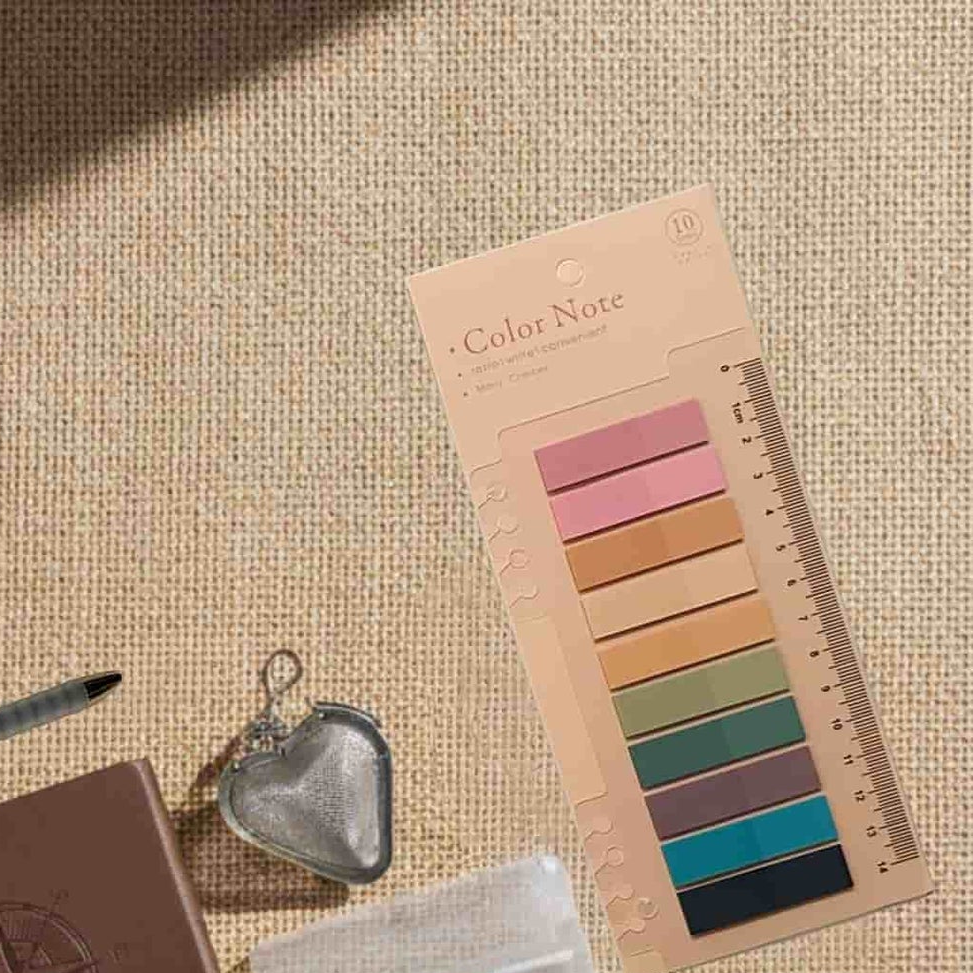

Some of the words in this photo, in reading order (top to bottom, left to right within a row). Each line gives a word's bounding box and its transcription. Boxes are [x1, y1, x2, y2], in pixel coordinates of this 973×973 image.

[463, 317, 544, 355] Color
[548, 291, 625, 328] Note
[720, 364, 730, 373] 0
[741, 436, 752, 444] 2
[753, 471, 763, 480] 3
[765, 508, 774, 516] 4
[776, 544, 786, 552] 5
[787, 578, 797, 587] 6
[798, 614, 808, 622] 7
[810, 650, 820, 658] 8
[831, 718, 843, 731] 10
[843, 753, 854, 766] 11
[855, 789, 865, 802] 12
[866, 825, 877, 838] 13
[877, 861, 889, 874] 14
